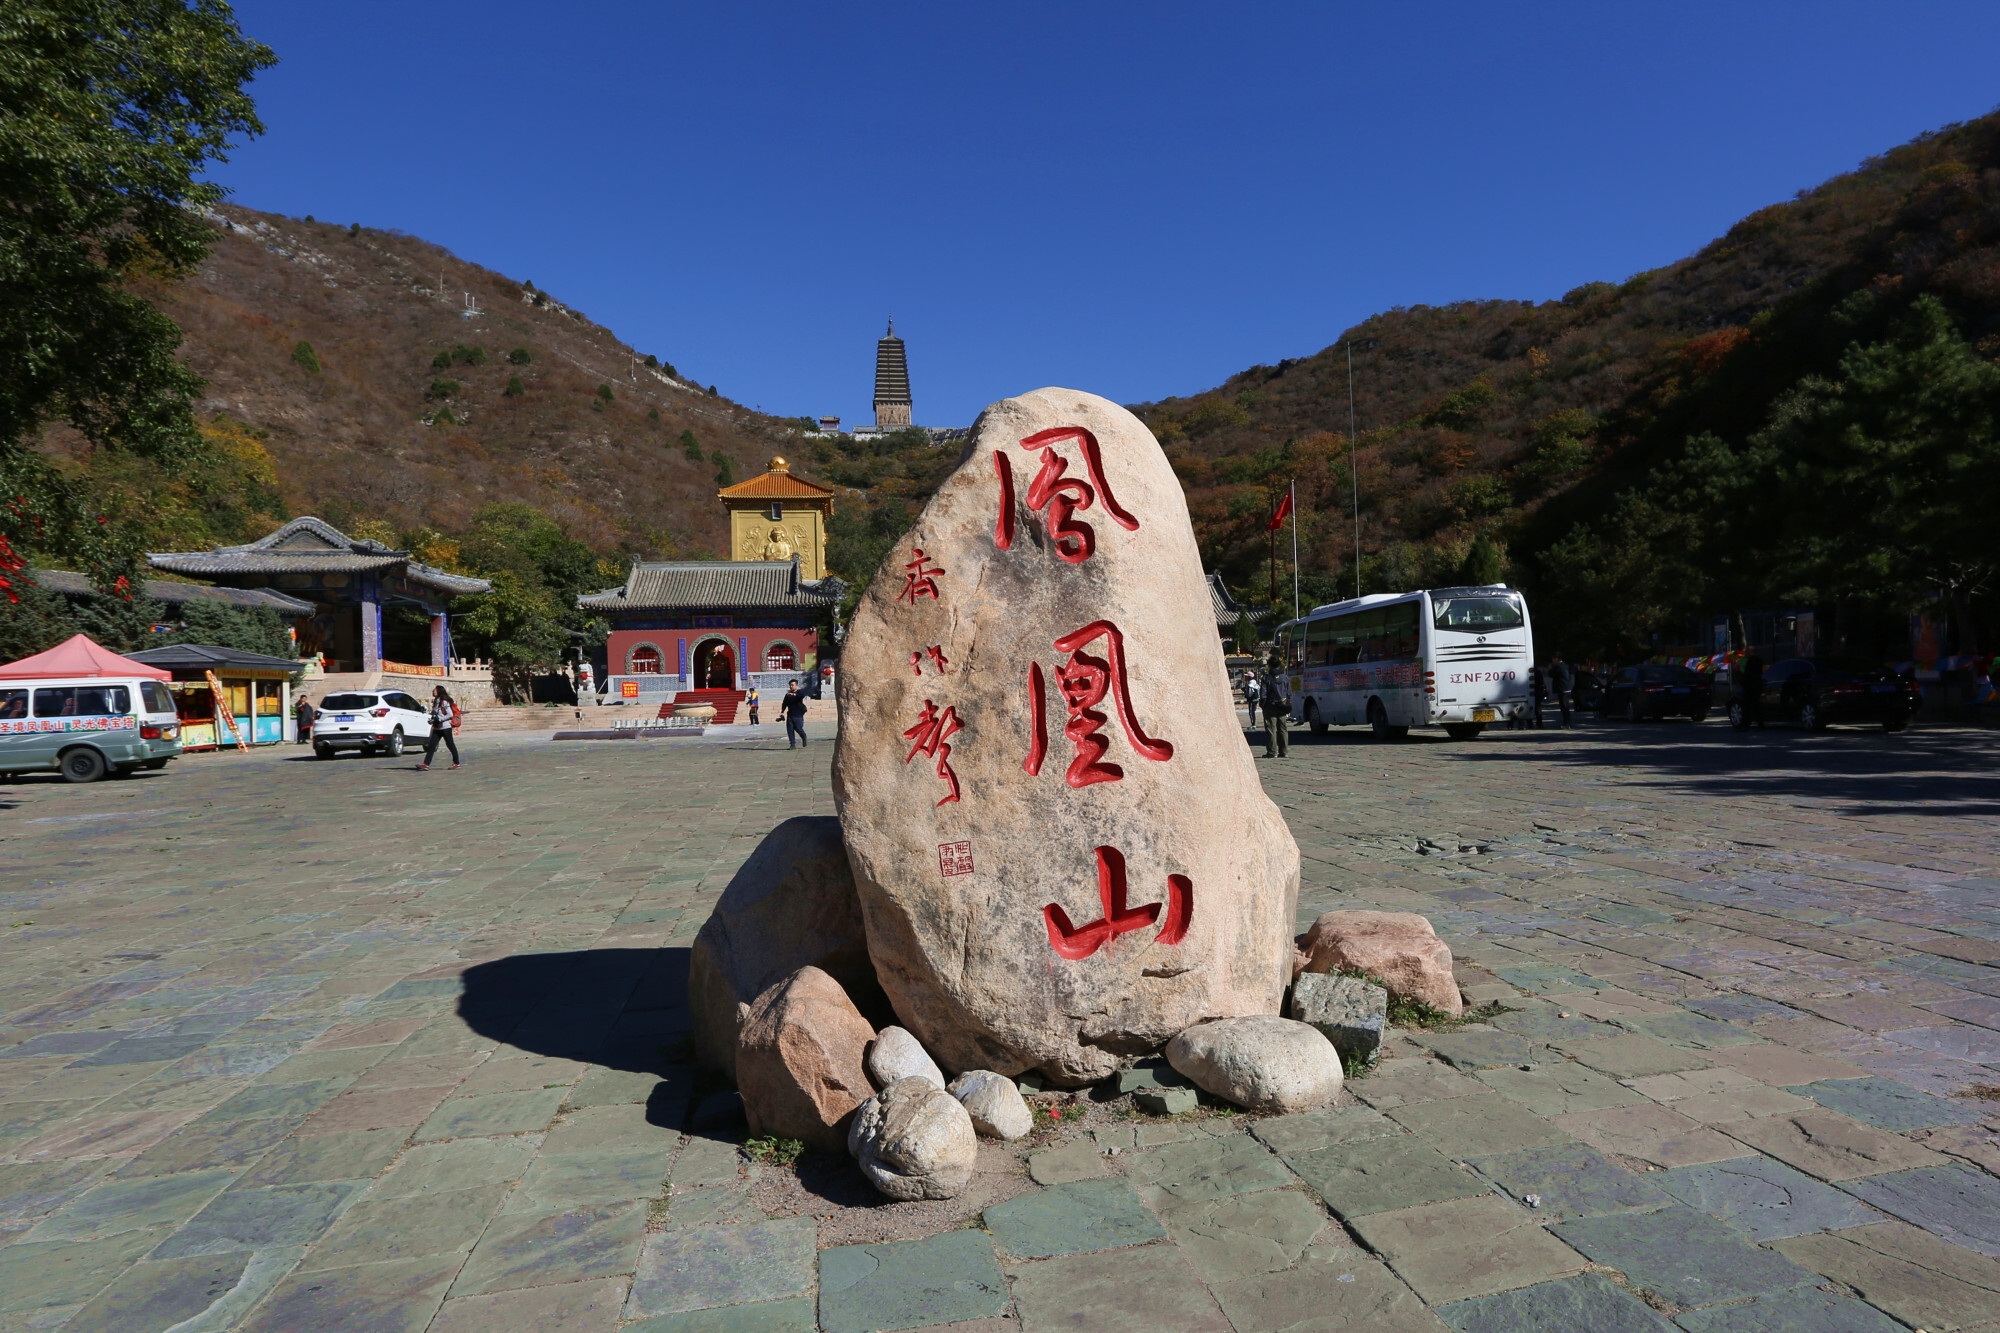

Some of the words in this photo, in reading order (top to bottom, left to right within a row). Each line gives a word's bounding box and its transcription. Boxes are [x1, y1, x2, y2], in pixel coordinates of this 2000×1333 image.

[1450, 671, 1516, 684] 辽NF2070
[0, 719, 65, 733] 圣境凤凰山
[71, 715, 136, 730] 灵光佛宝塔
